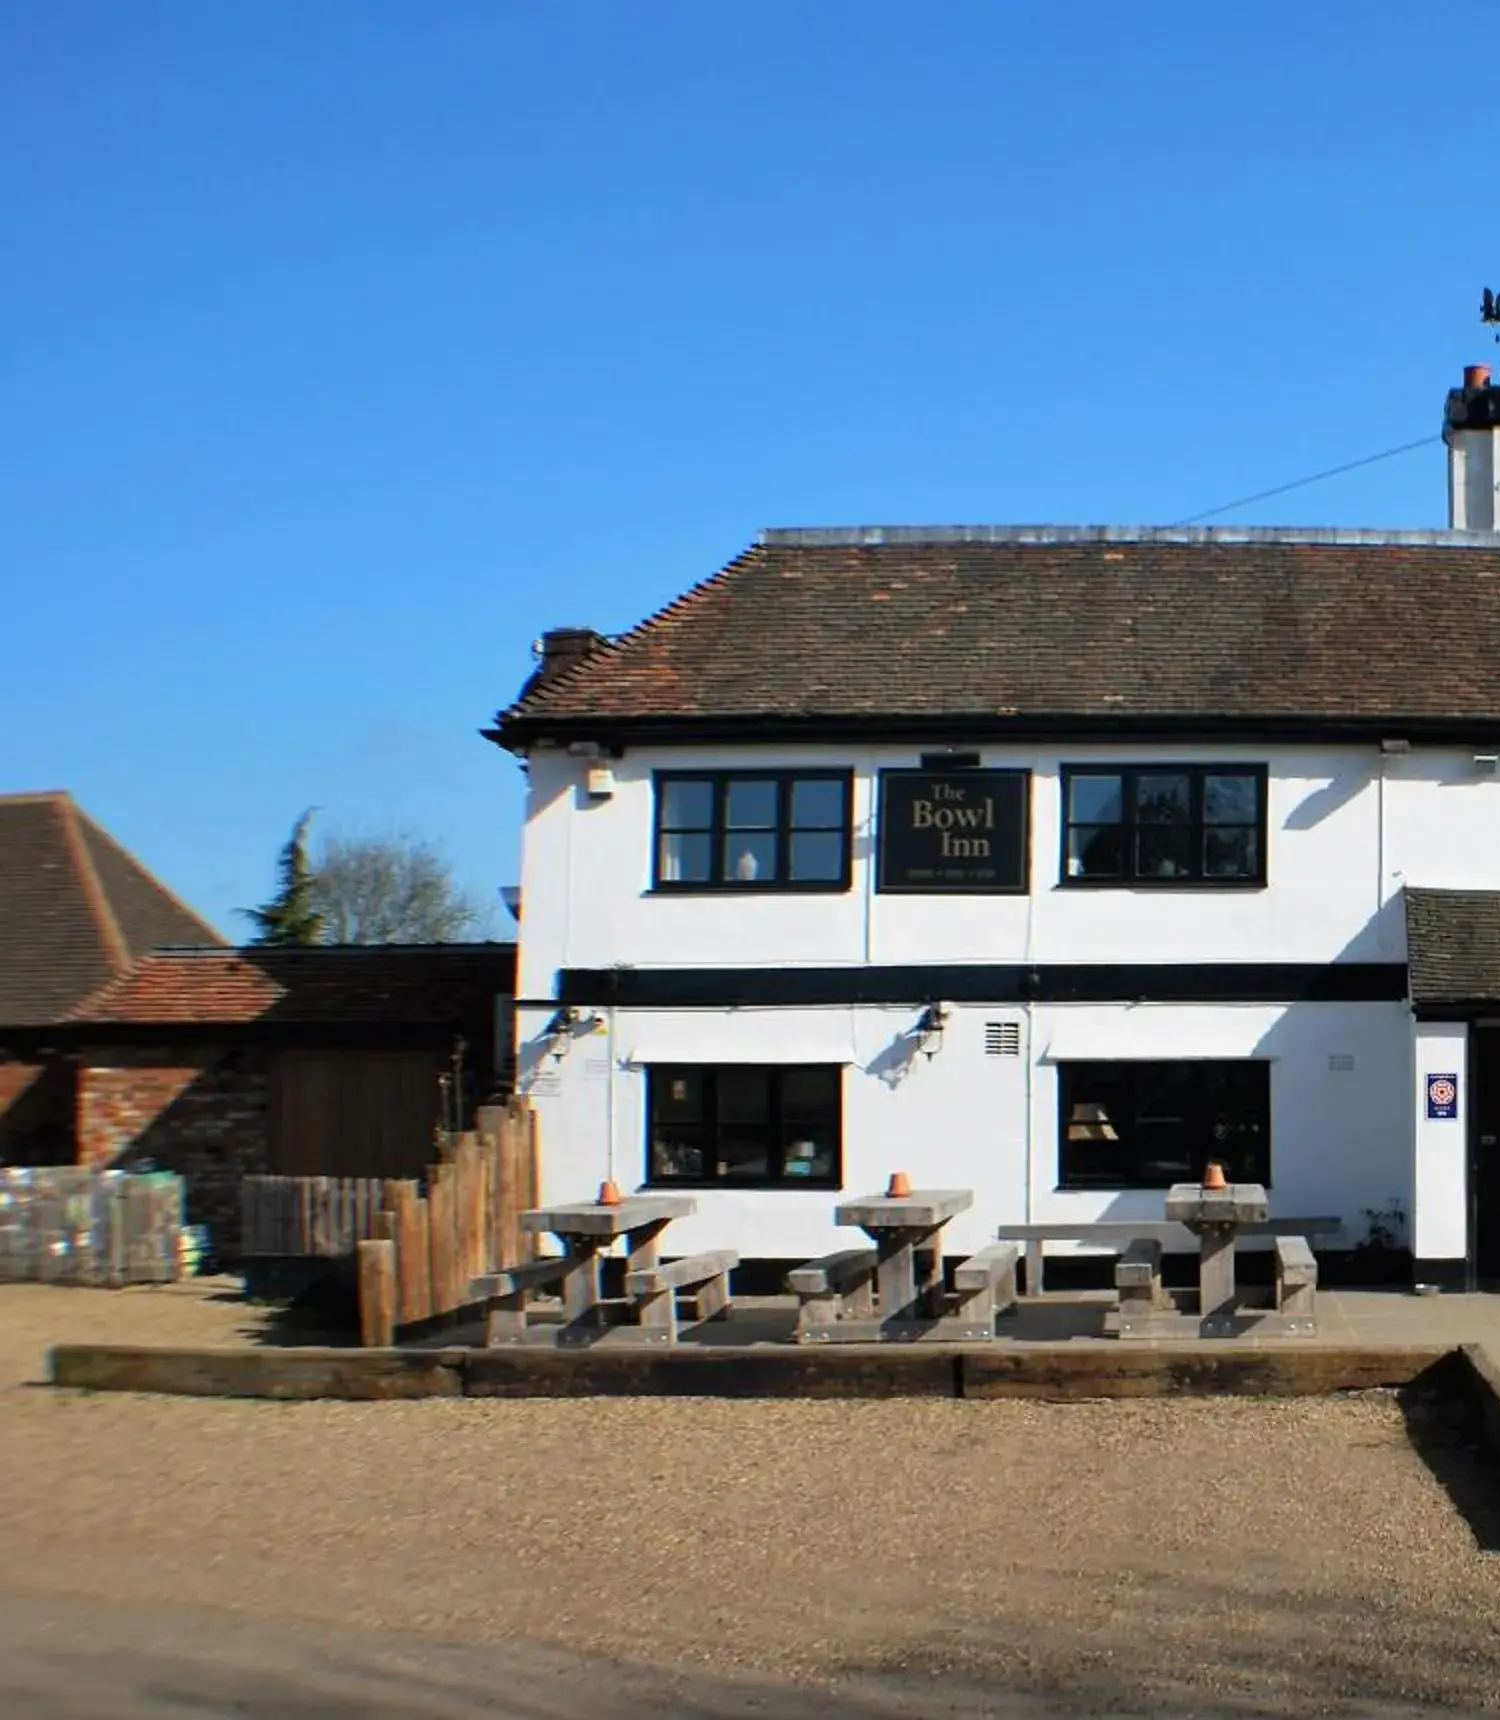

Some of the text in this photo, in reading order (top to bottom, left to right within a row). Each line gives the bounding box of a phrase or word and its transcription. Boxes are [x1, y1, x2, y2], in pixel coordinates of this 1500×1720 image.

[931, 783, 967, 801] The
[912, 797, 994, 830] Bowl
[940, 832, 991, 857] Inn
